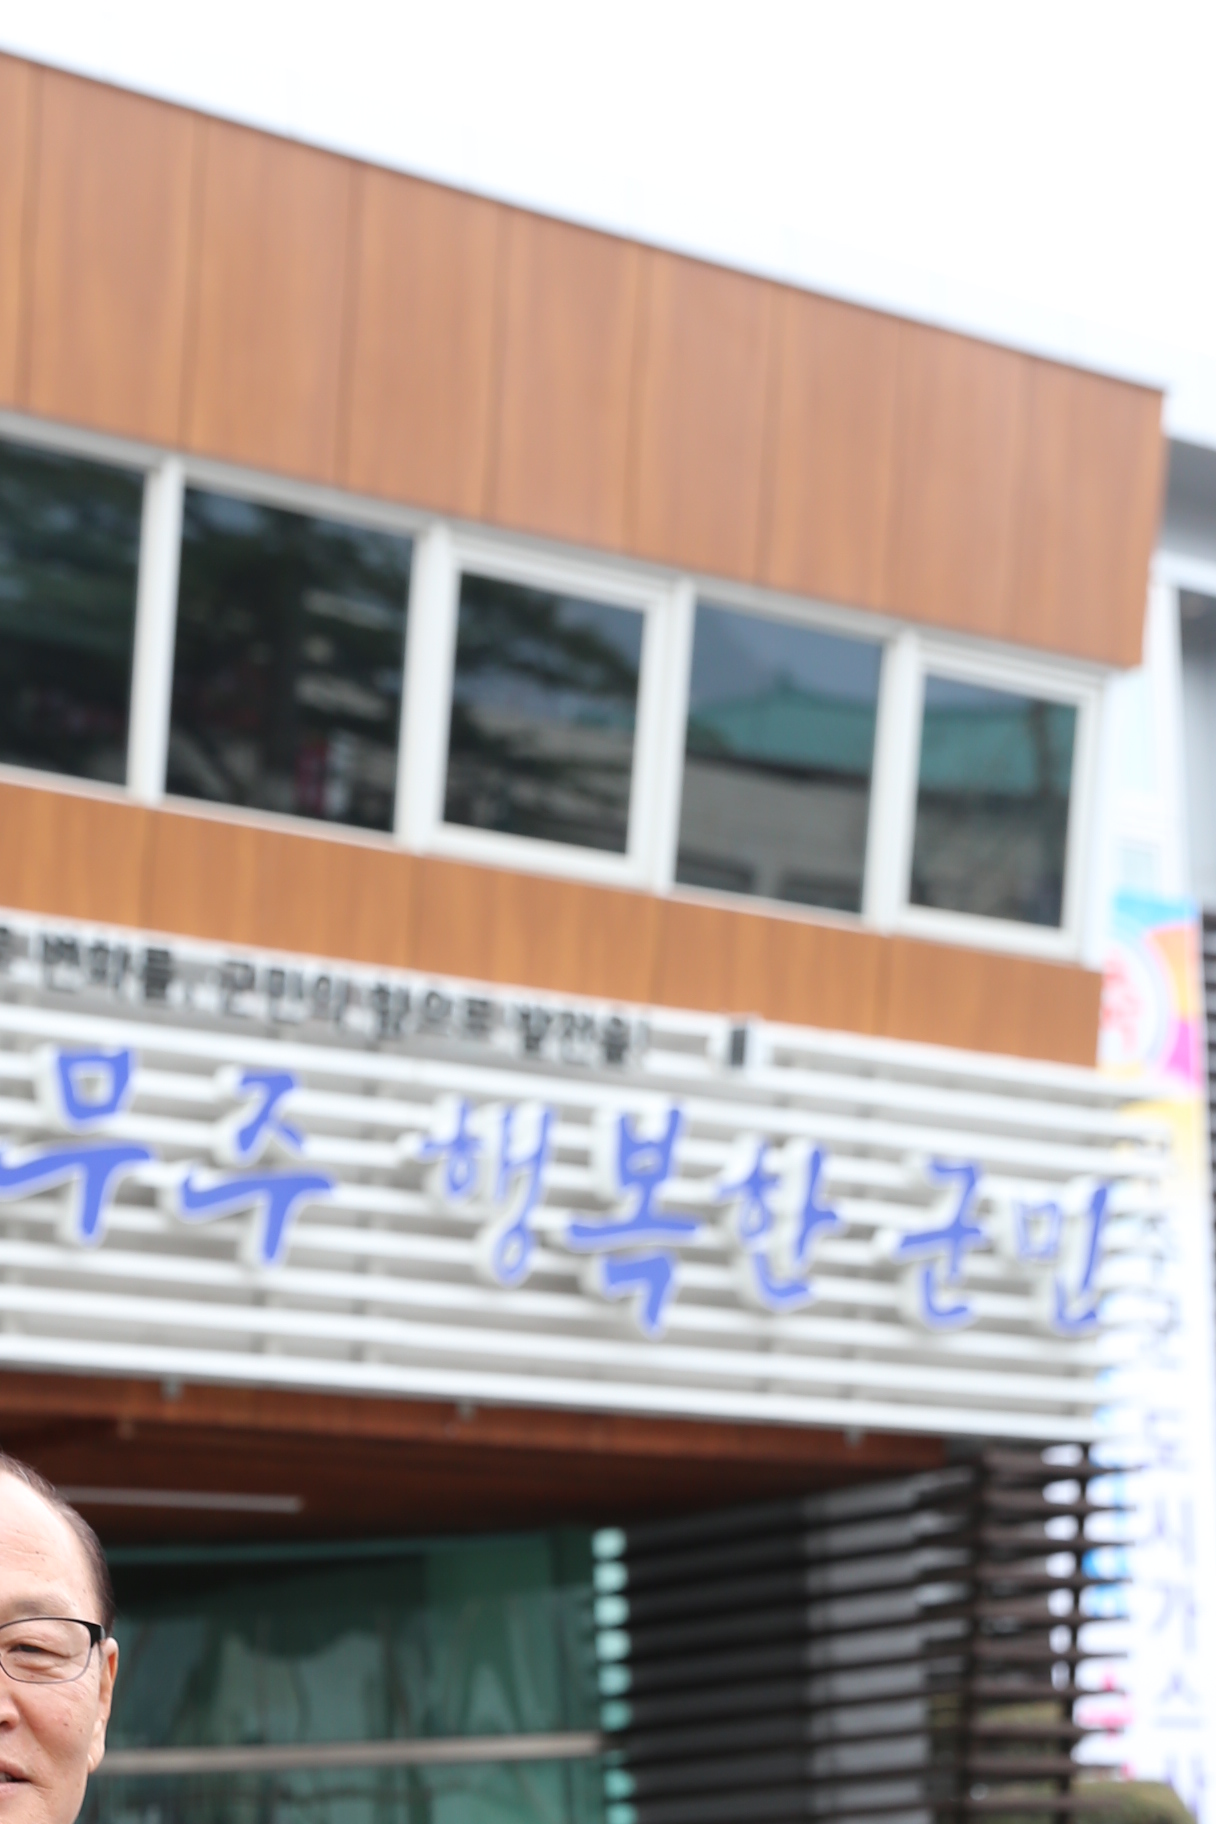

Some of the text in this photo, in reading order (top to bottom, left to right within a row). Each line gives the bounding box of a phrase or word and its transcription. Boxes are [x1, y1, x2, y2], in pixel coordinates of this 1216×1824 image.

[222, 960, 349, 1031] 군민의
[416, 1100, 842, 1334] 행복한
[890, 1158, 1112, 1332] 군민
